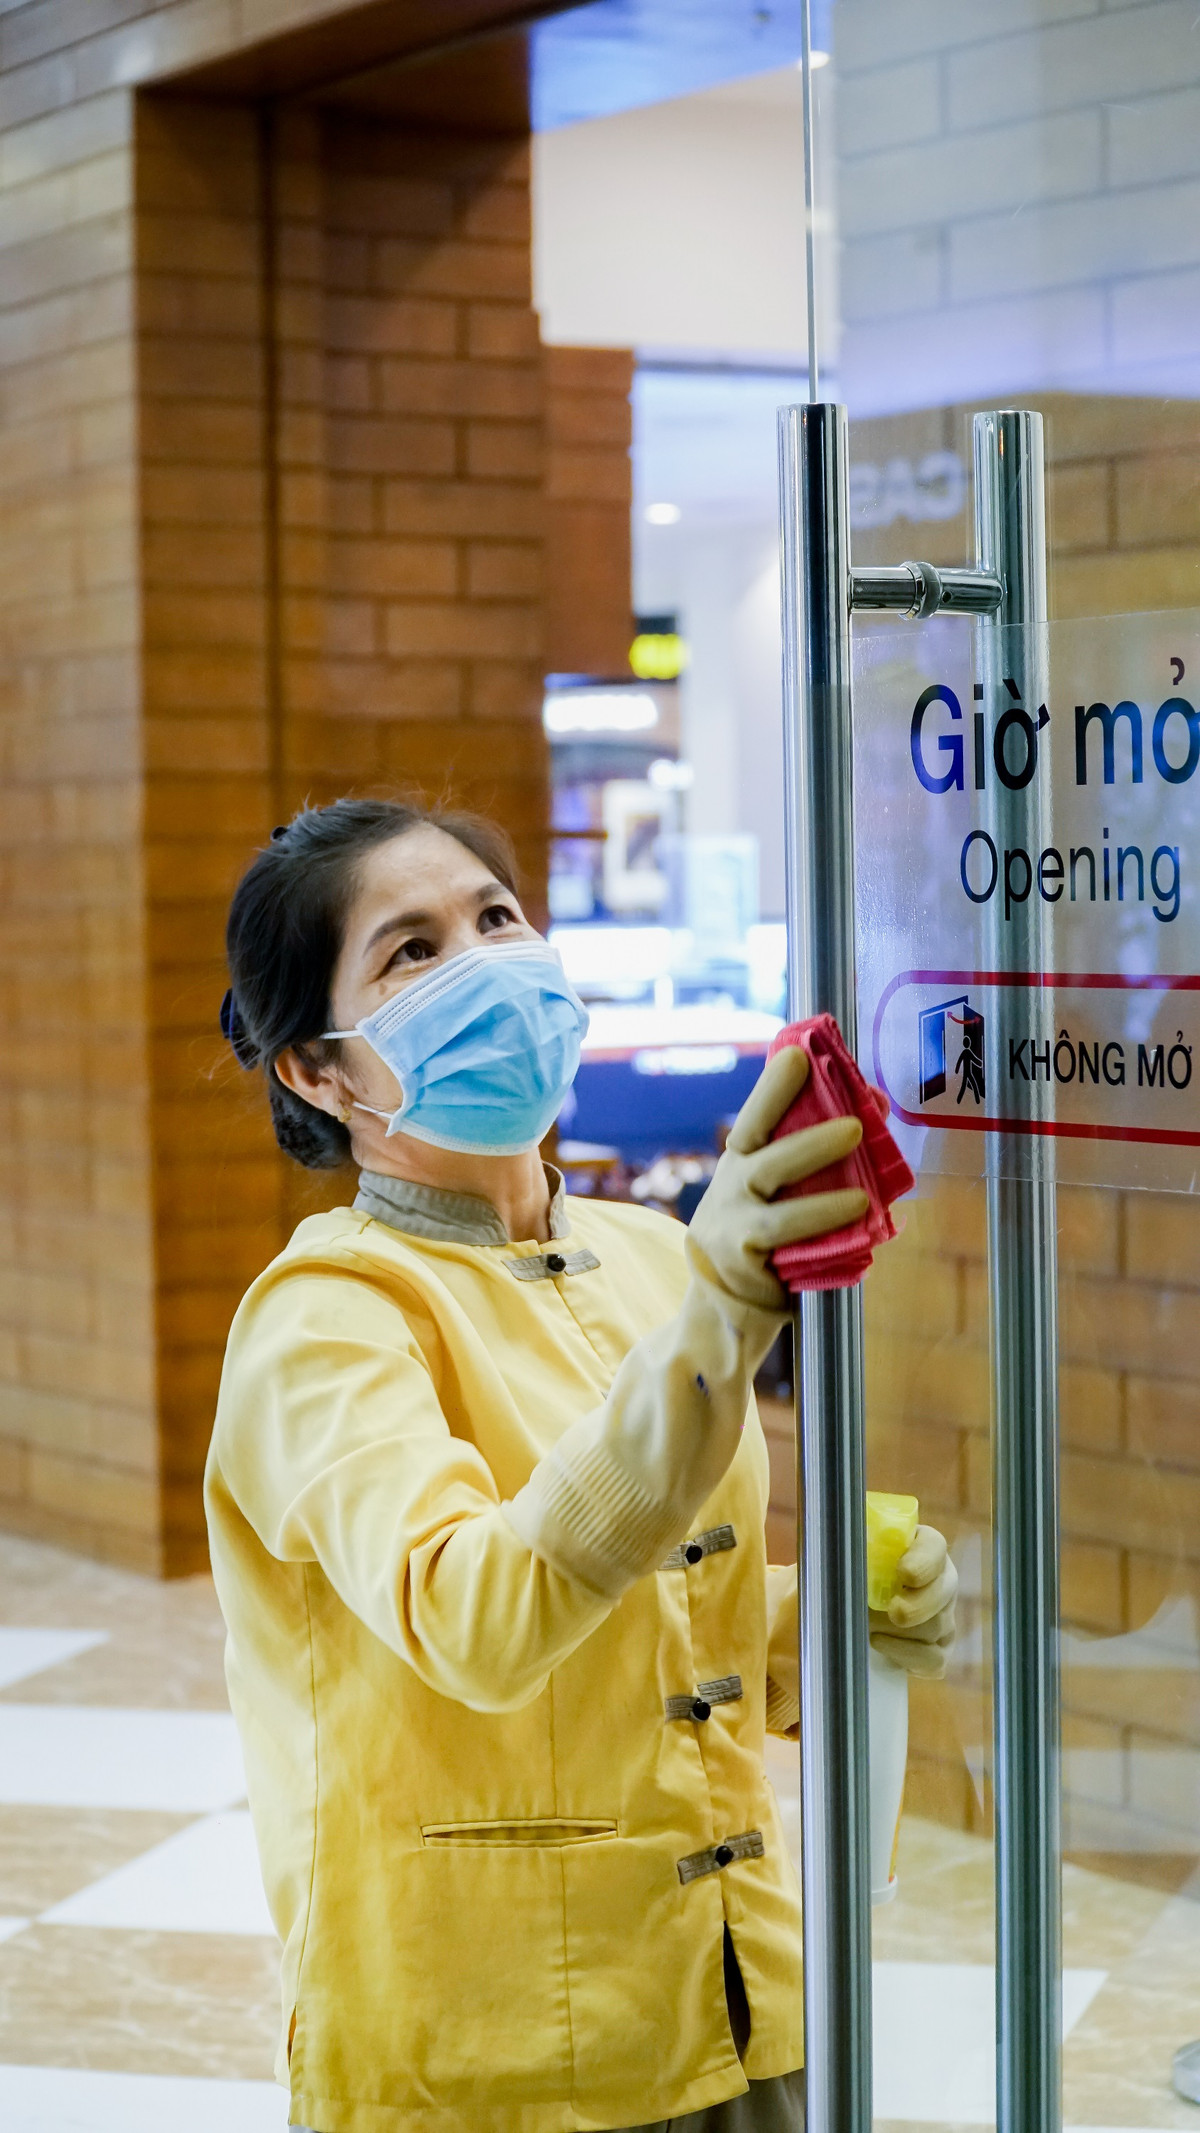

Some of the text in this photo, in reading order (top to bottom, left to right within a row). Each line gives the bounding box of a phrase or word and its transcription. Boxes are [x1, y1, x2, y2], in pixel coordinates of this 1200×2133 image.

[910, 656, 1200, 794] Giờ mở
[960, 827, 1180, 923] Opening
[1008, 1029, 1192, 1090] KHÔNG MỞ
